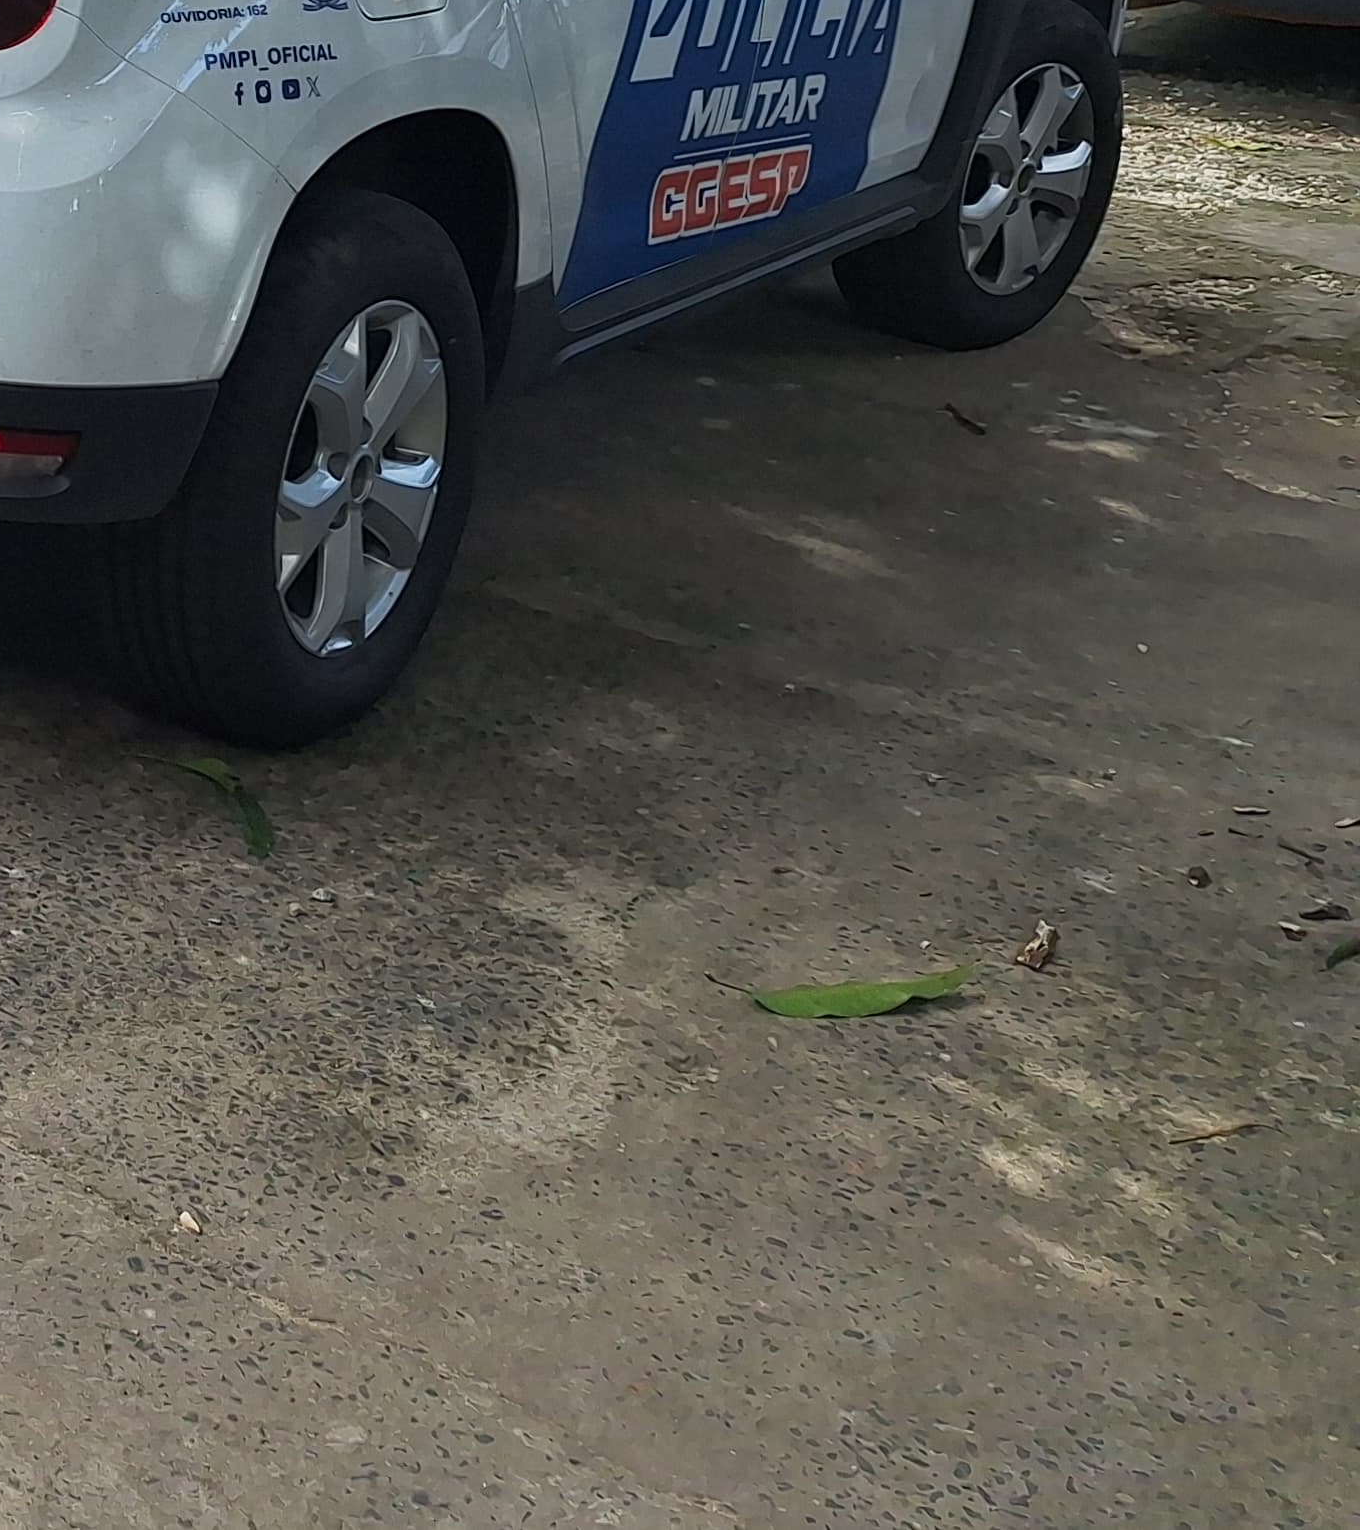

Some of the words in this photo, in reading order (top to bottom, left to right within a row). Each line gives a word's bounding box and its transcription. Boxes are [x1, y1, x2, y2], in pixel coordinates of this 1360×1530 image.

[160, 8, 245, 24] OUVIDORIA:
[247, 4, 269, 17] 162
[203, 43, 338, 71] PMPI_OFICIAL
[679, 73, 827, 142] MILITAR
[648, 144, 813, 246] CGESP
